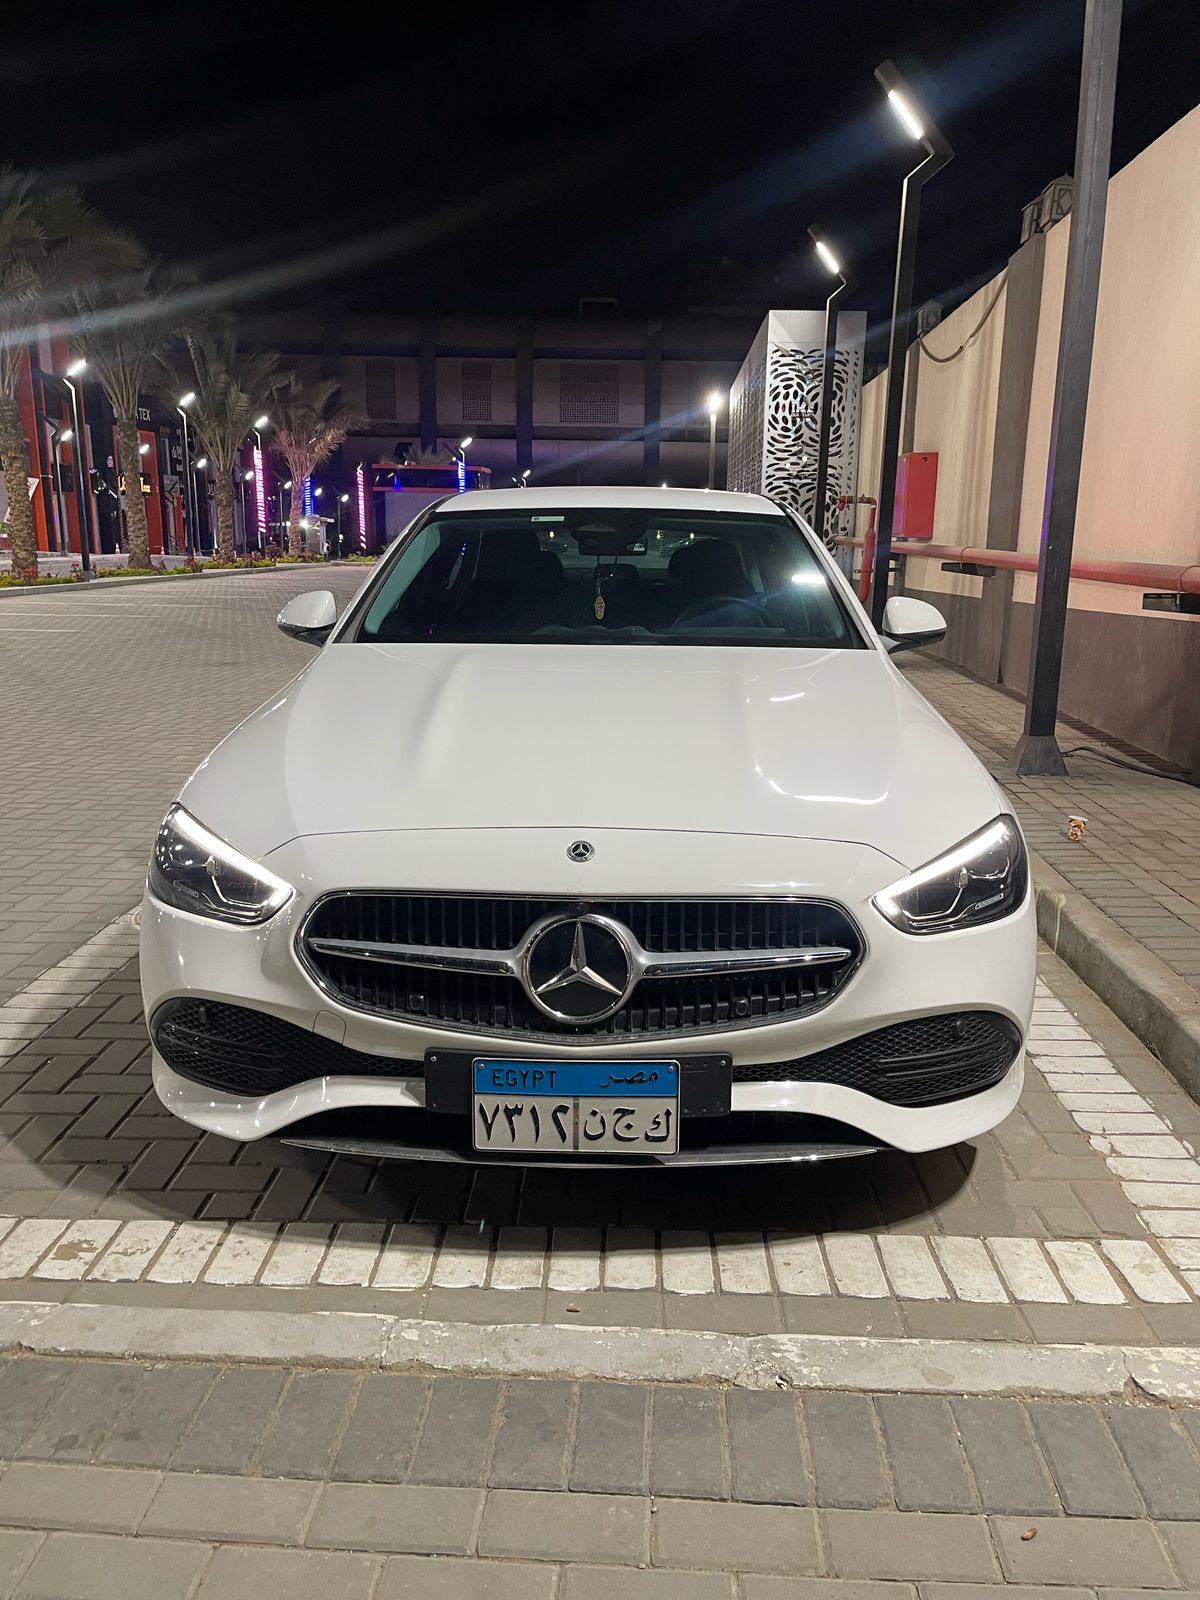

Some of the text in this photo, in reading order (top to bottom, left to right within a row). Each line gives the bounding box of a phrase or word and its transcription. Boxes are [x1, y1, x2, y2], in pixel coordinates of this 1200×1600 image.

[492, 1068, 558, 1089] EGYPT
[600, 1070, 659, 1089] مصر
[479, 1102, 570, 1144] ٧٣١٢
